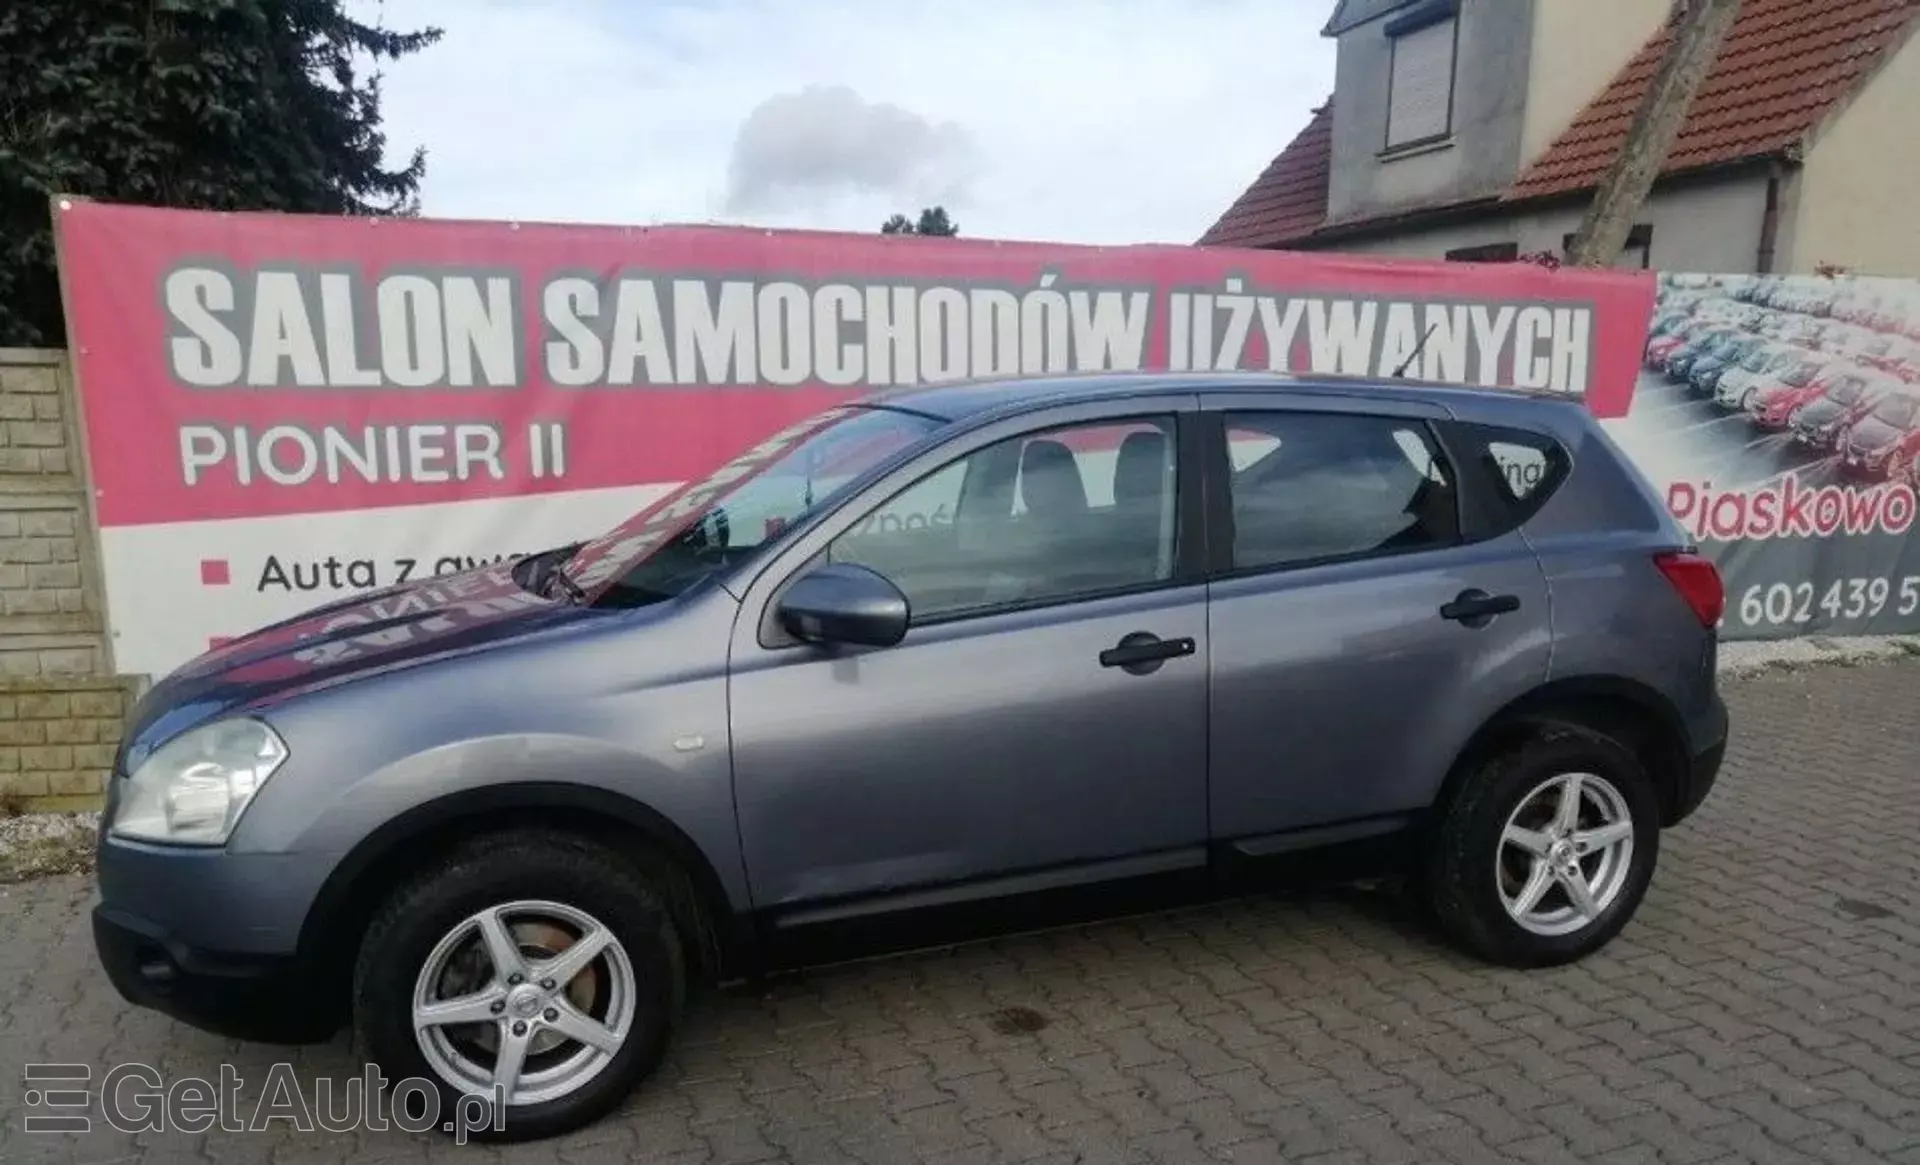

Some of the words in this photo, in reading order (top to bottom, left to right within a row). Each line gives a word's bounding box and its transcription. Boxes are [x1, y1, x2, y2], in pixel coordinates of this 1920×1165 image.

[166, 267, 517, 387] SALON
[543, 274, 1150, 385] SAMOCHODÓW
[1169, 278, 1591, 392] UŻYWANYCH
[179, 423, 503, 486] PIONIER
[1667, 473, 1916, 541] Piaskowo
[257, 554, 377, 592] Auta
[394, 558, 417, 583] z
[1739, 581, 1815, 626] 602
[1820, 576, 1890, 619] 439
